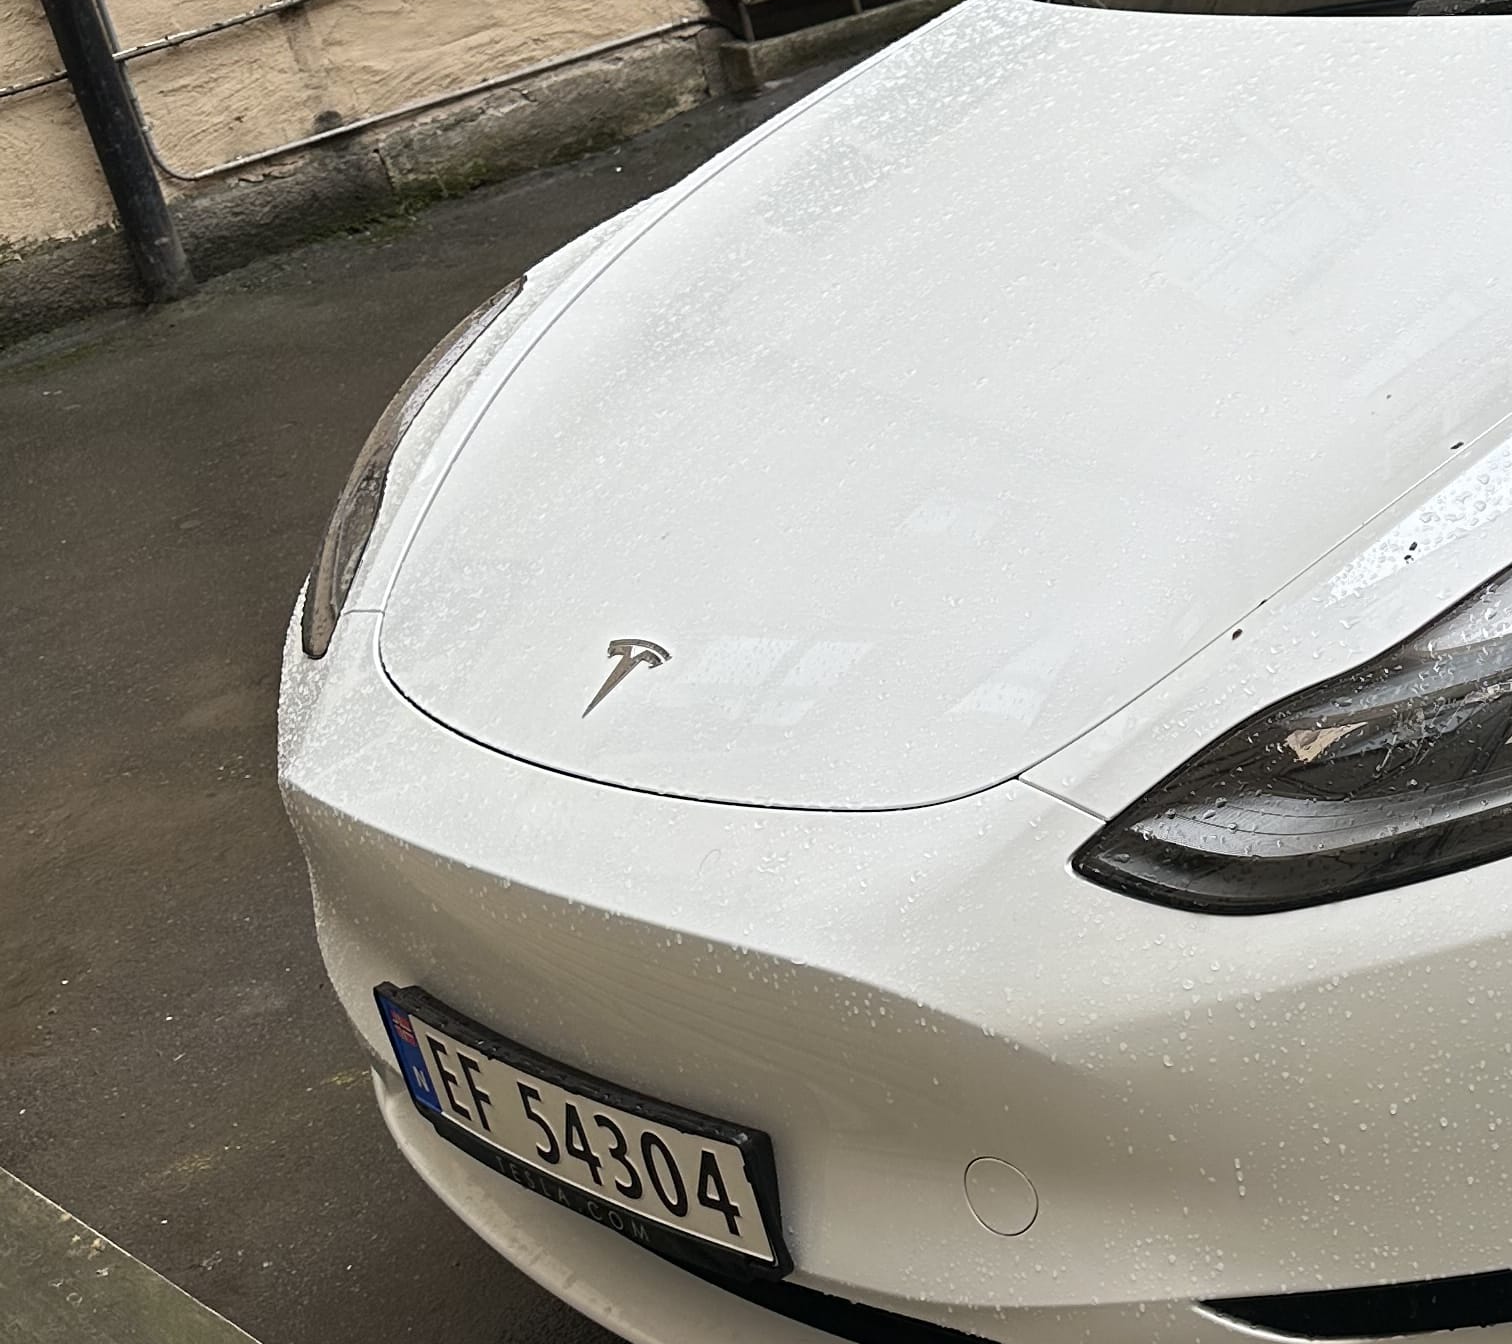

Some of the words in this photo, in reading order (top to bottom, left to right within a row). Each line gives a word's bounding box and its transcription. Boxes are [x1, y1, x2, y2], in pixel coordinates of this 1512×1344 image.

[412, 1064, 431, 1093] N
[425, 1033, 492, 1132] EF
[516, 1080, 742, 1237] 54304
[495, 1154, 651, 1242] TESLA.COM
